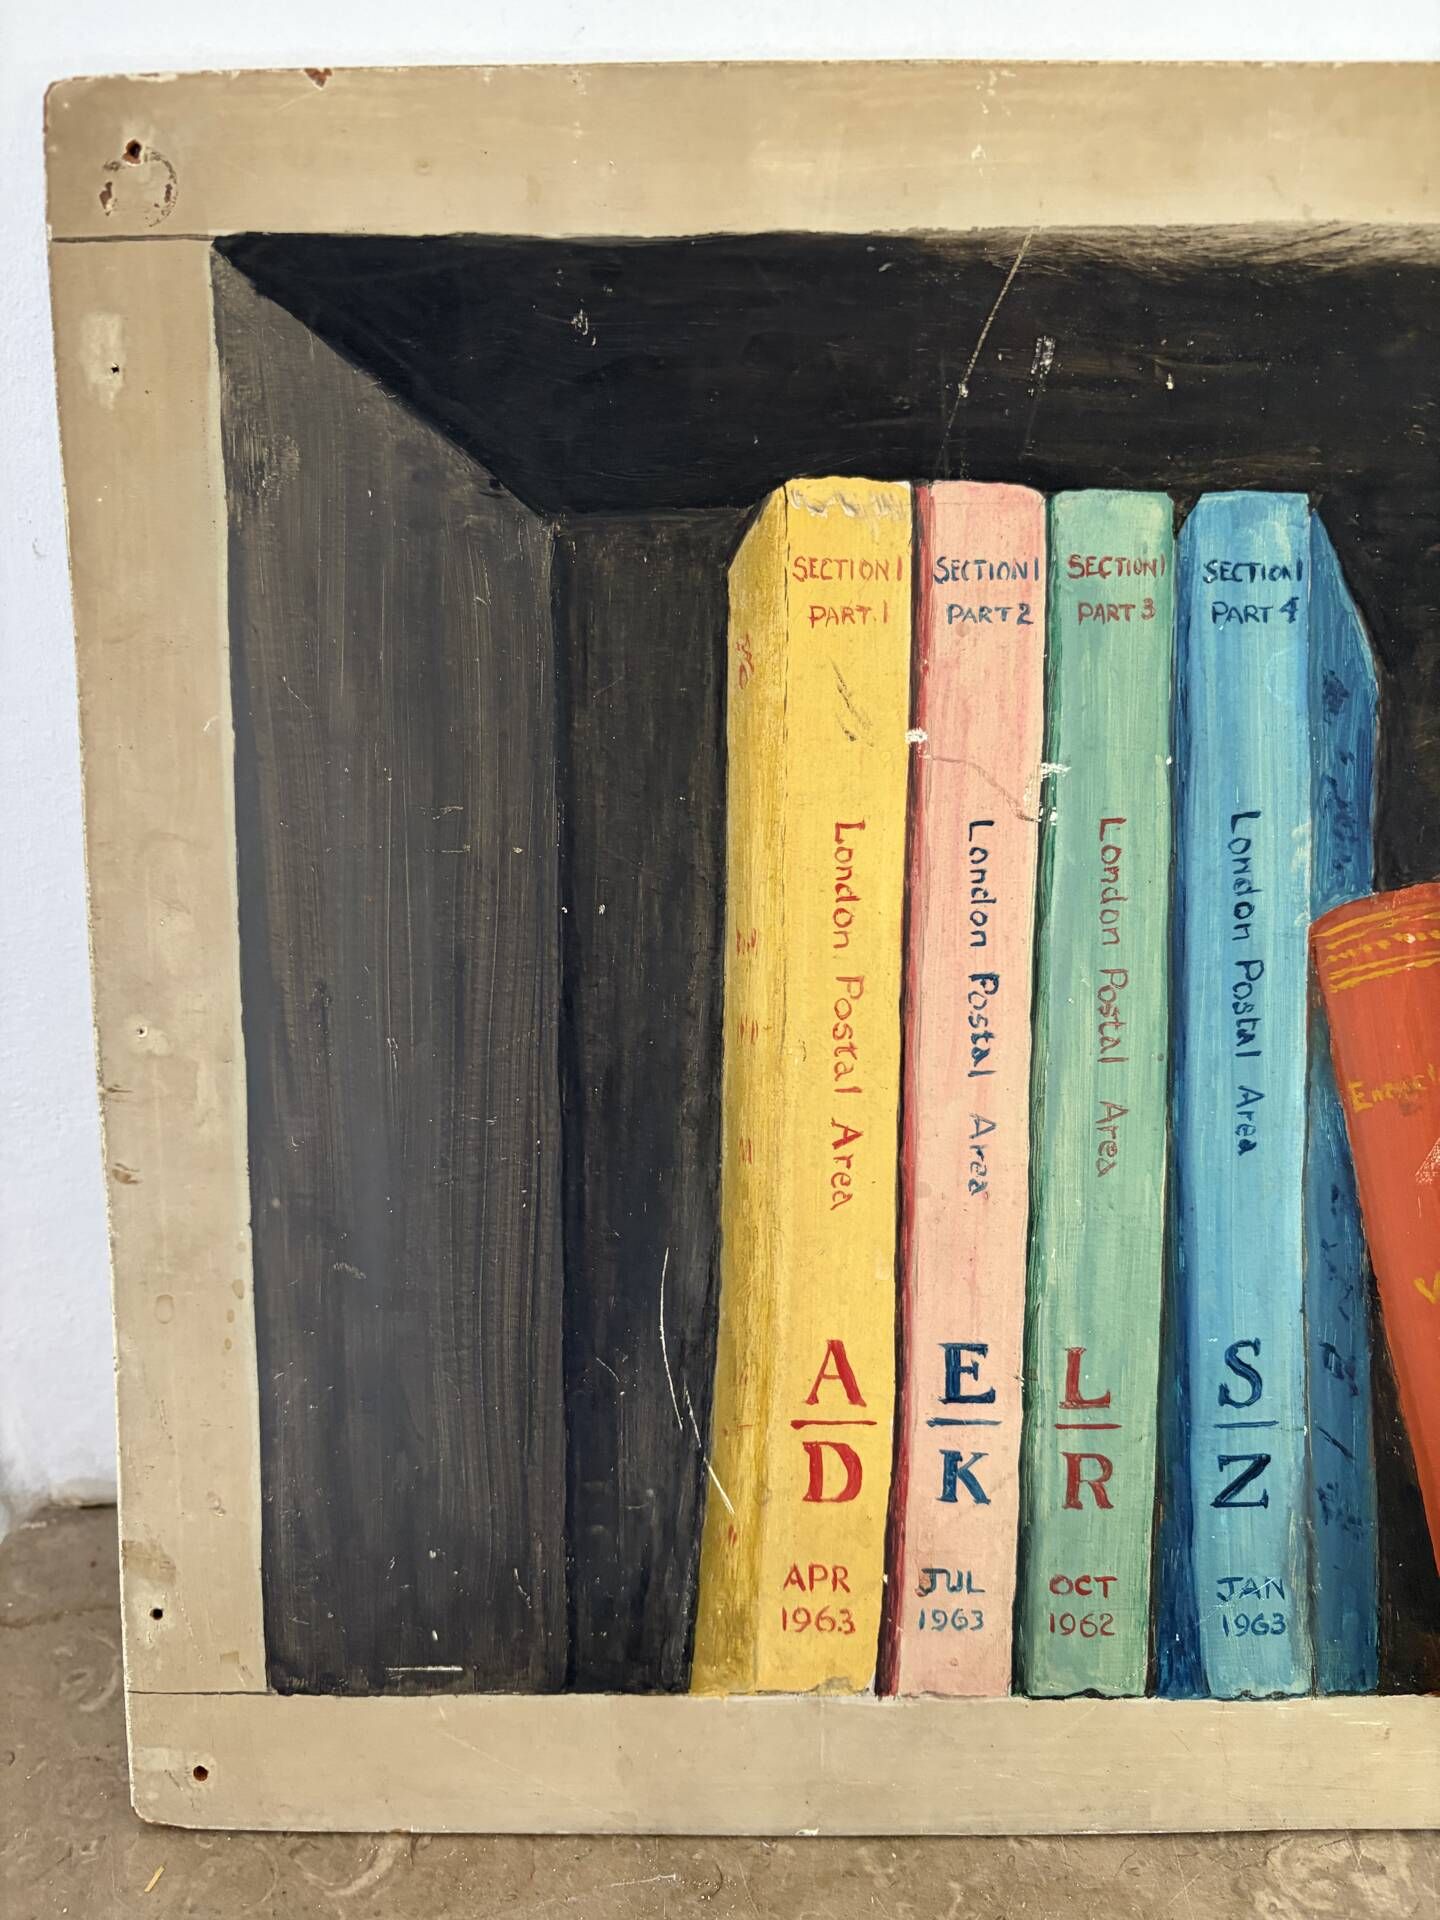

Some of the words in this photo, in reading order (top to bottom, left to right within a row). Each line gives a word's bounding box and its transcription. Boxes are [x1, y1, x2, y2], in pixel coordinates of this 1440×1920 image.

[947, 603, 1013, 625] PART
[1016, 603, 1034, 625] 2
[1078, 602, 1136, 625] PART
[1141, 598, 1157, 620] 3
[1211, 601, 1274, 625] PART
[1279, 597, 1300, 625] 4
[831, 819, 866, 949] London
[968, 820, 998, 948] London
[1099, 816, 1128, 946] London
[1228, 810, 1264, 942] London
[830, 974, 865, 1094] Postal
[967, 972, 1000, 1078] Postal
[1097, 968, 1129, 1064] Postal
[1231, 959, 1265, 1058] Postal
[1096, 1100, 1129, 1178] Area
[1237, 1085, 1266, 1156] Area
[829, 1117, 864, 1211] Area
[967, 1112, 998, 1197] Area
[806, 1339, 868, 1407] A
[938, 1342, 997, 1405] E
[1059, 1346, 1112, 1410] L
[1218, 1337, 1263, 1409] S
[802, 1440, 863, 1504] D
[938, 1448, 992, 1505] K
[1062, 1450, 1115, 1511] R
[1210, 1453, 1272, 1510] Z
[783, 1563, 851, 1594] APR
[914, 1567, 987, 1597] JUL
[1049, 1574, 1118, 1598] OCT
[1216, 1576, 1286, 1602] JAN
[781, 1606, 857, 1635] 1963
[918, 1608, 986, 1633] 1963
[1049, 1612, 1116, 1638] 1962
[1222, 1612, 1287, 1638] 1963
